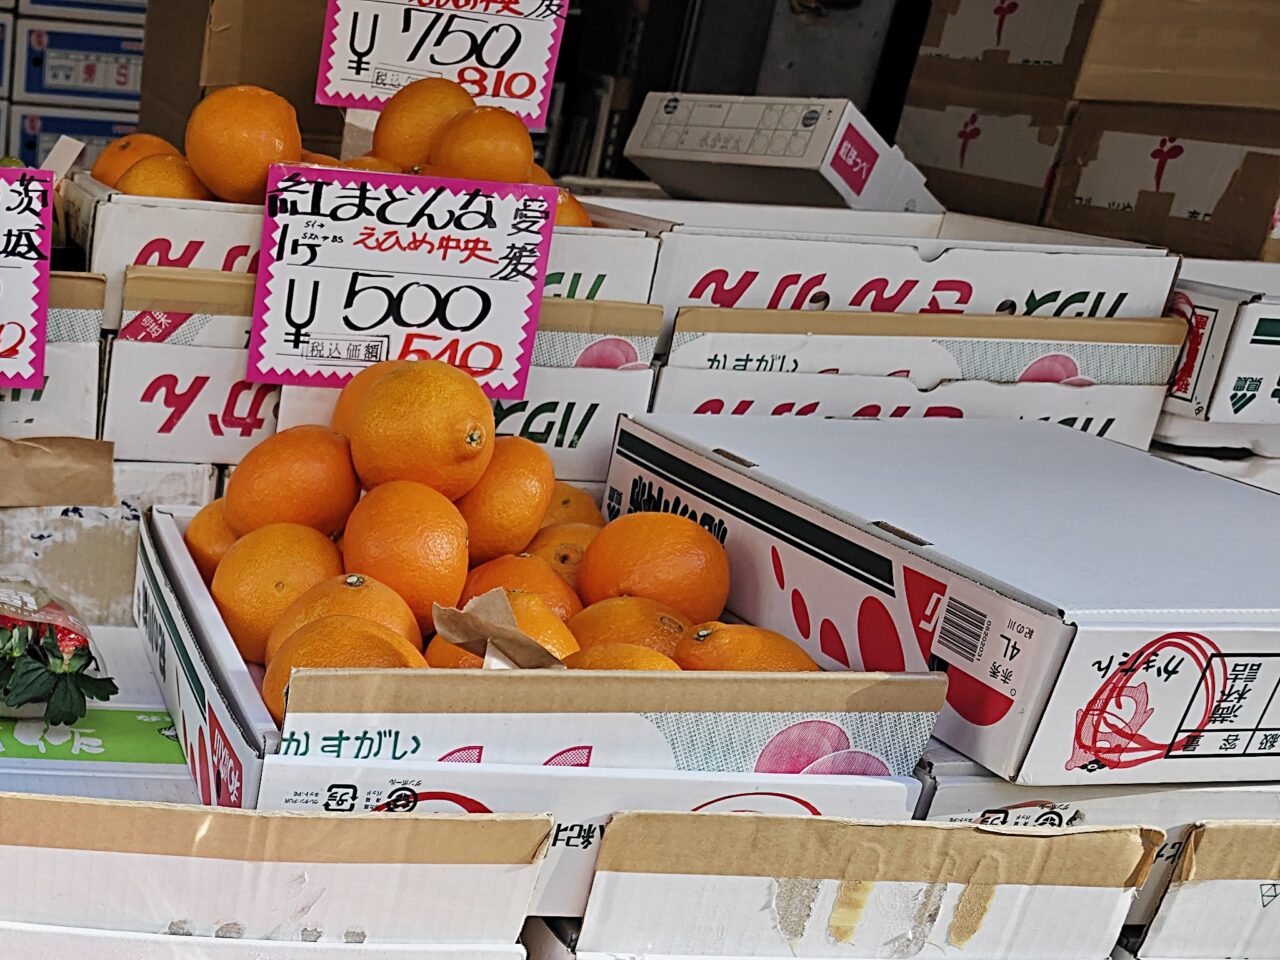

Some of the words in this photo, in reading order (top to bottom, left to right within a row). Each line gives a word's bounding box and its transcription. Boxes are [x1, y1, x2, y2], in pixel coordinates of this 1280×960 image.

[401, 7, 522, 68] 750
[456, 66, 537, 99] 810
[267, 172, 497, 231] 紅まどんな
[353, 226, 500, 264] えひめ中央
[342, 272, 492, 332] 500
[309, 341, 381, 362] 税込価額
[398, 333, 503, 378] 540
[997, 633, 1023, 662] 4L
